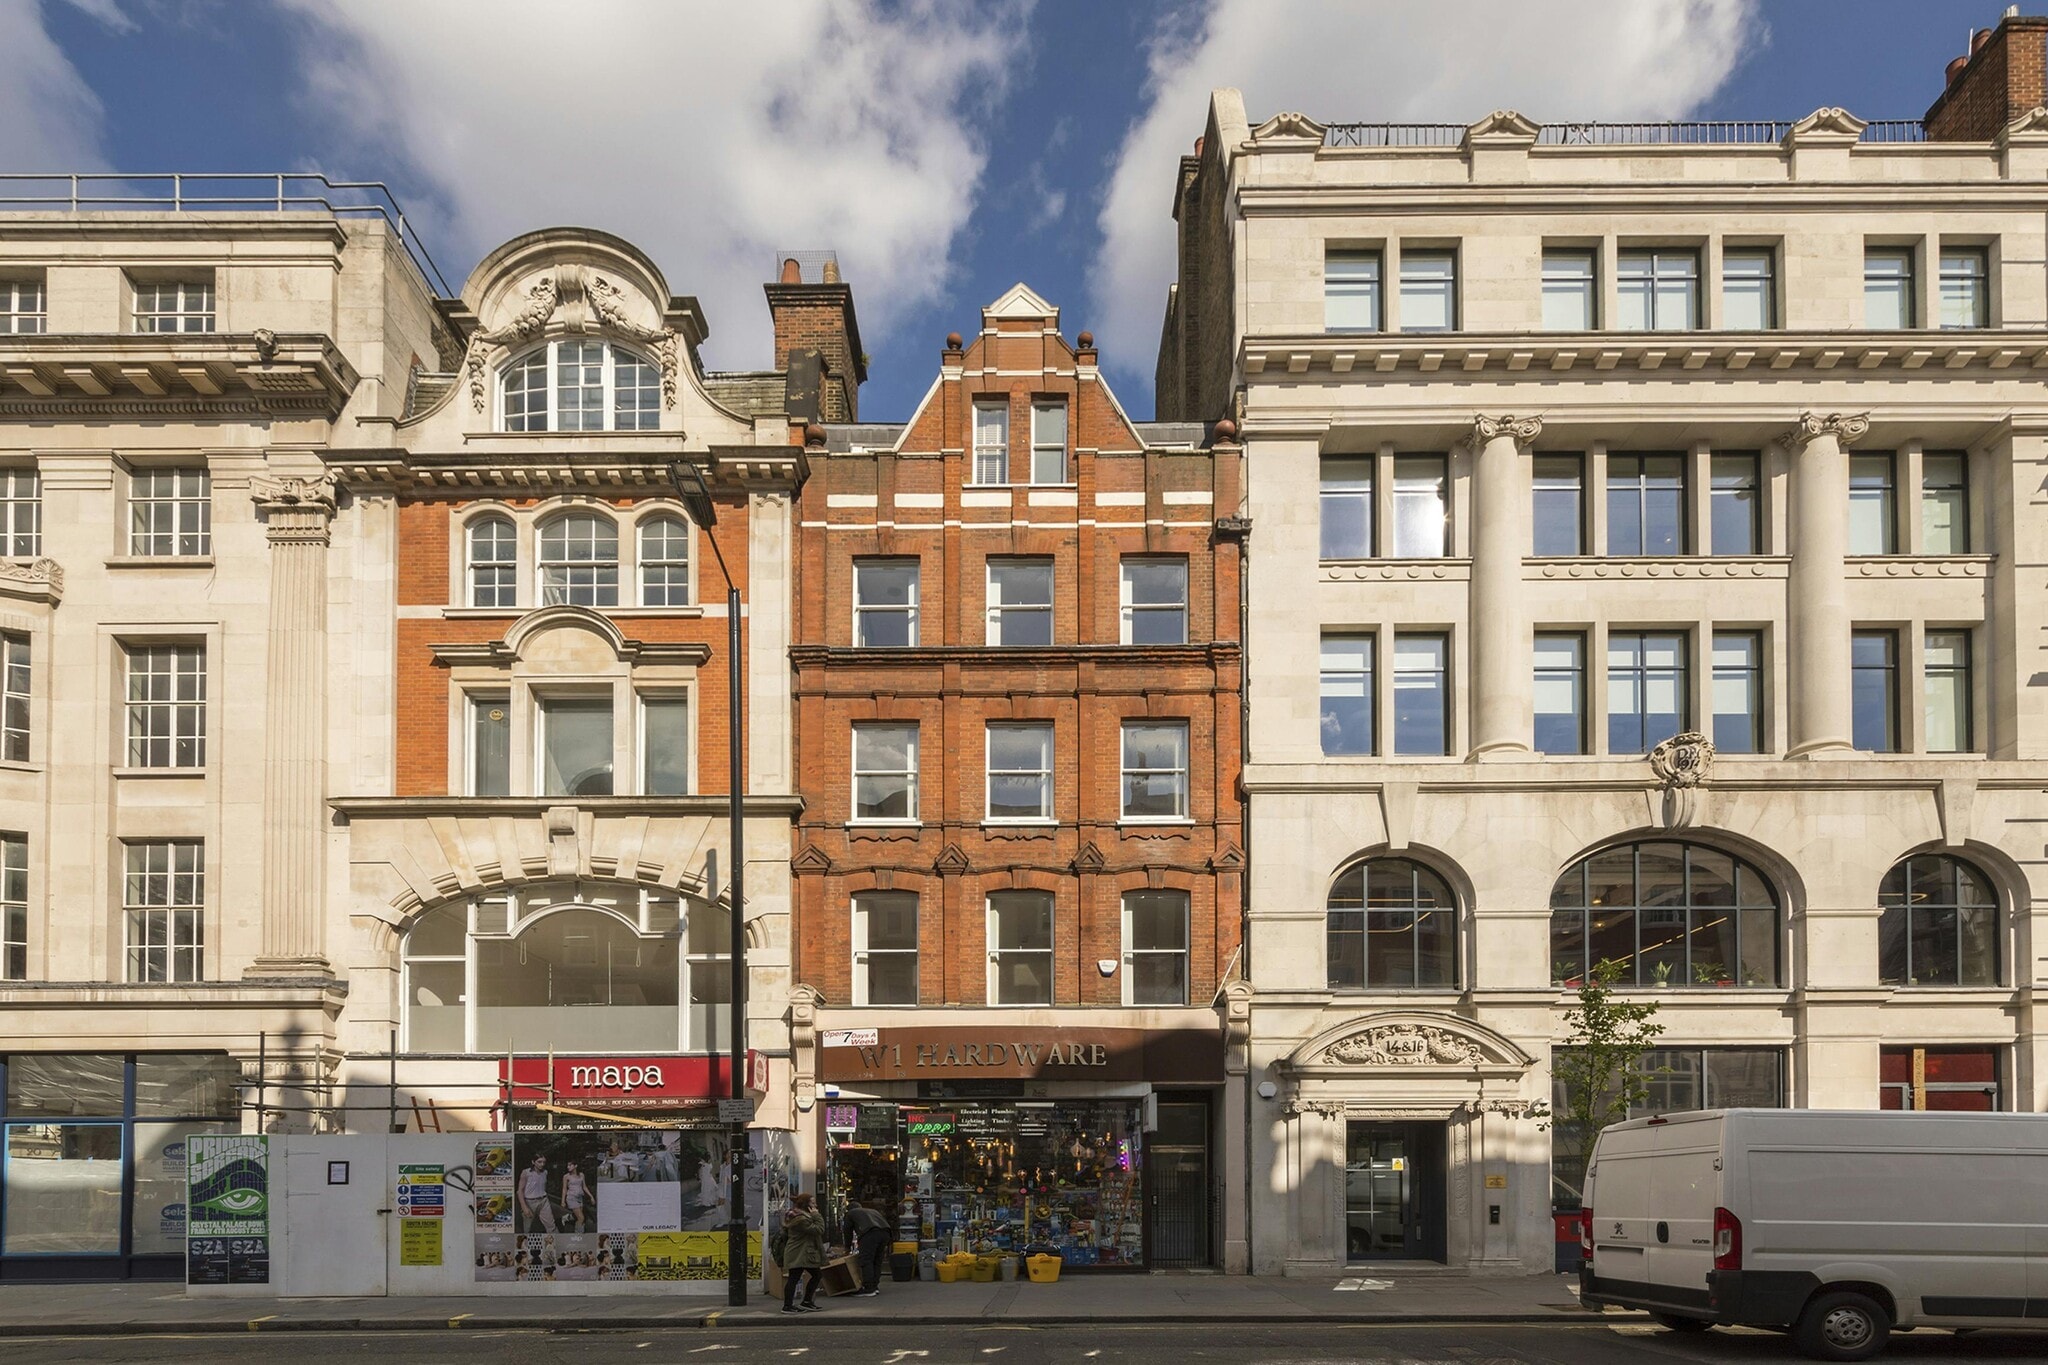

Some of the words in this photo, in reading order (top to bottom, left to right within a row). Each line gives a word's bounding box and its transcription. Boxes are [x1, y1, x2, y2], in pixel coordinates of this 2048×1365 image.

[823, 1031, 844, 1039] Open
[843, 1031, 853, 1043] 7
[915, 1042, 1108, 1068] HARDWARE
[571, 1065, 665, 1093] mapa
[190, 1136, 267, 1165] PRIMAL
[190, 1145, 267, 1186] SCREAM
[190, 1220, 220, 1229] CRYSTAL
[221, 1220, 247, 1229] PALACE
[191, 1240, 226, 1256] SZA
[231, 1239, 266, 1255] SZA
